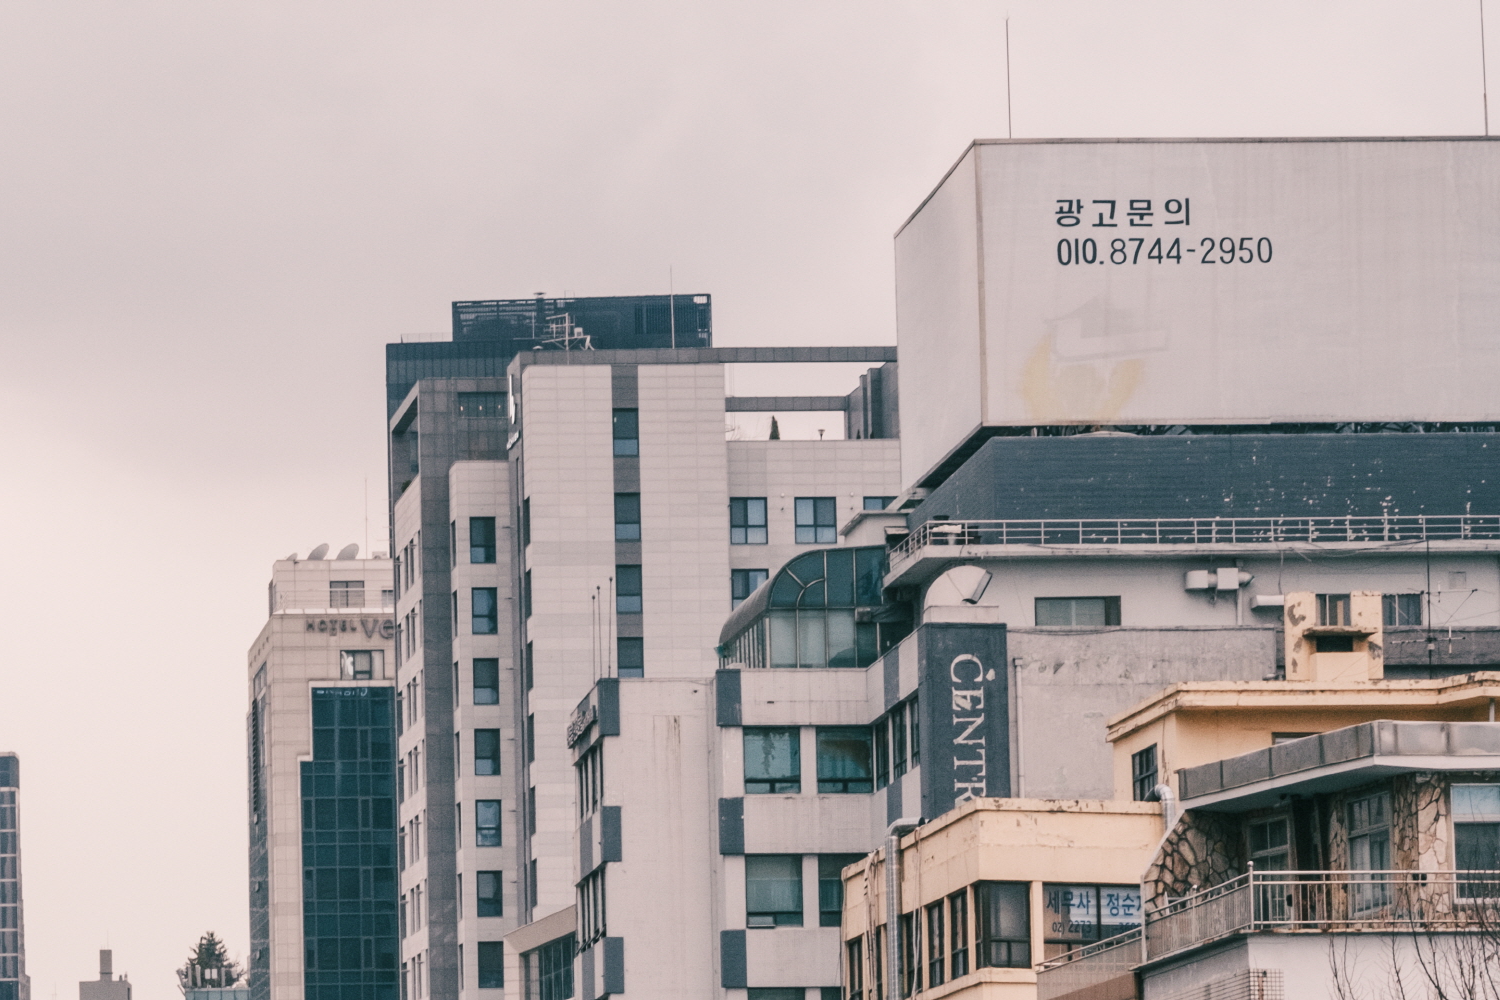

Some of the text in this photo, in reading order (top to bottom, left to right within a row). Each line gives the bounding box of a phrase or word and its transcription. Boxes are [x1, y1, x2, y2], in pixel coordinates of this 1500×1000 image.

[1055, 198, 1190, 228] 광고문의
[1056, 236, 1273, 266] 010.8744-2950
[1046, 890, 1091, 915] 세무사
[1052, 921, 1065, 934] 02)
[1068, 920, 1092, 933] 2273
